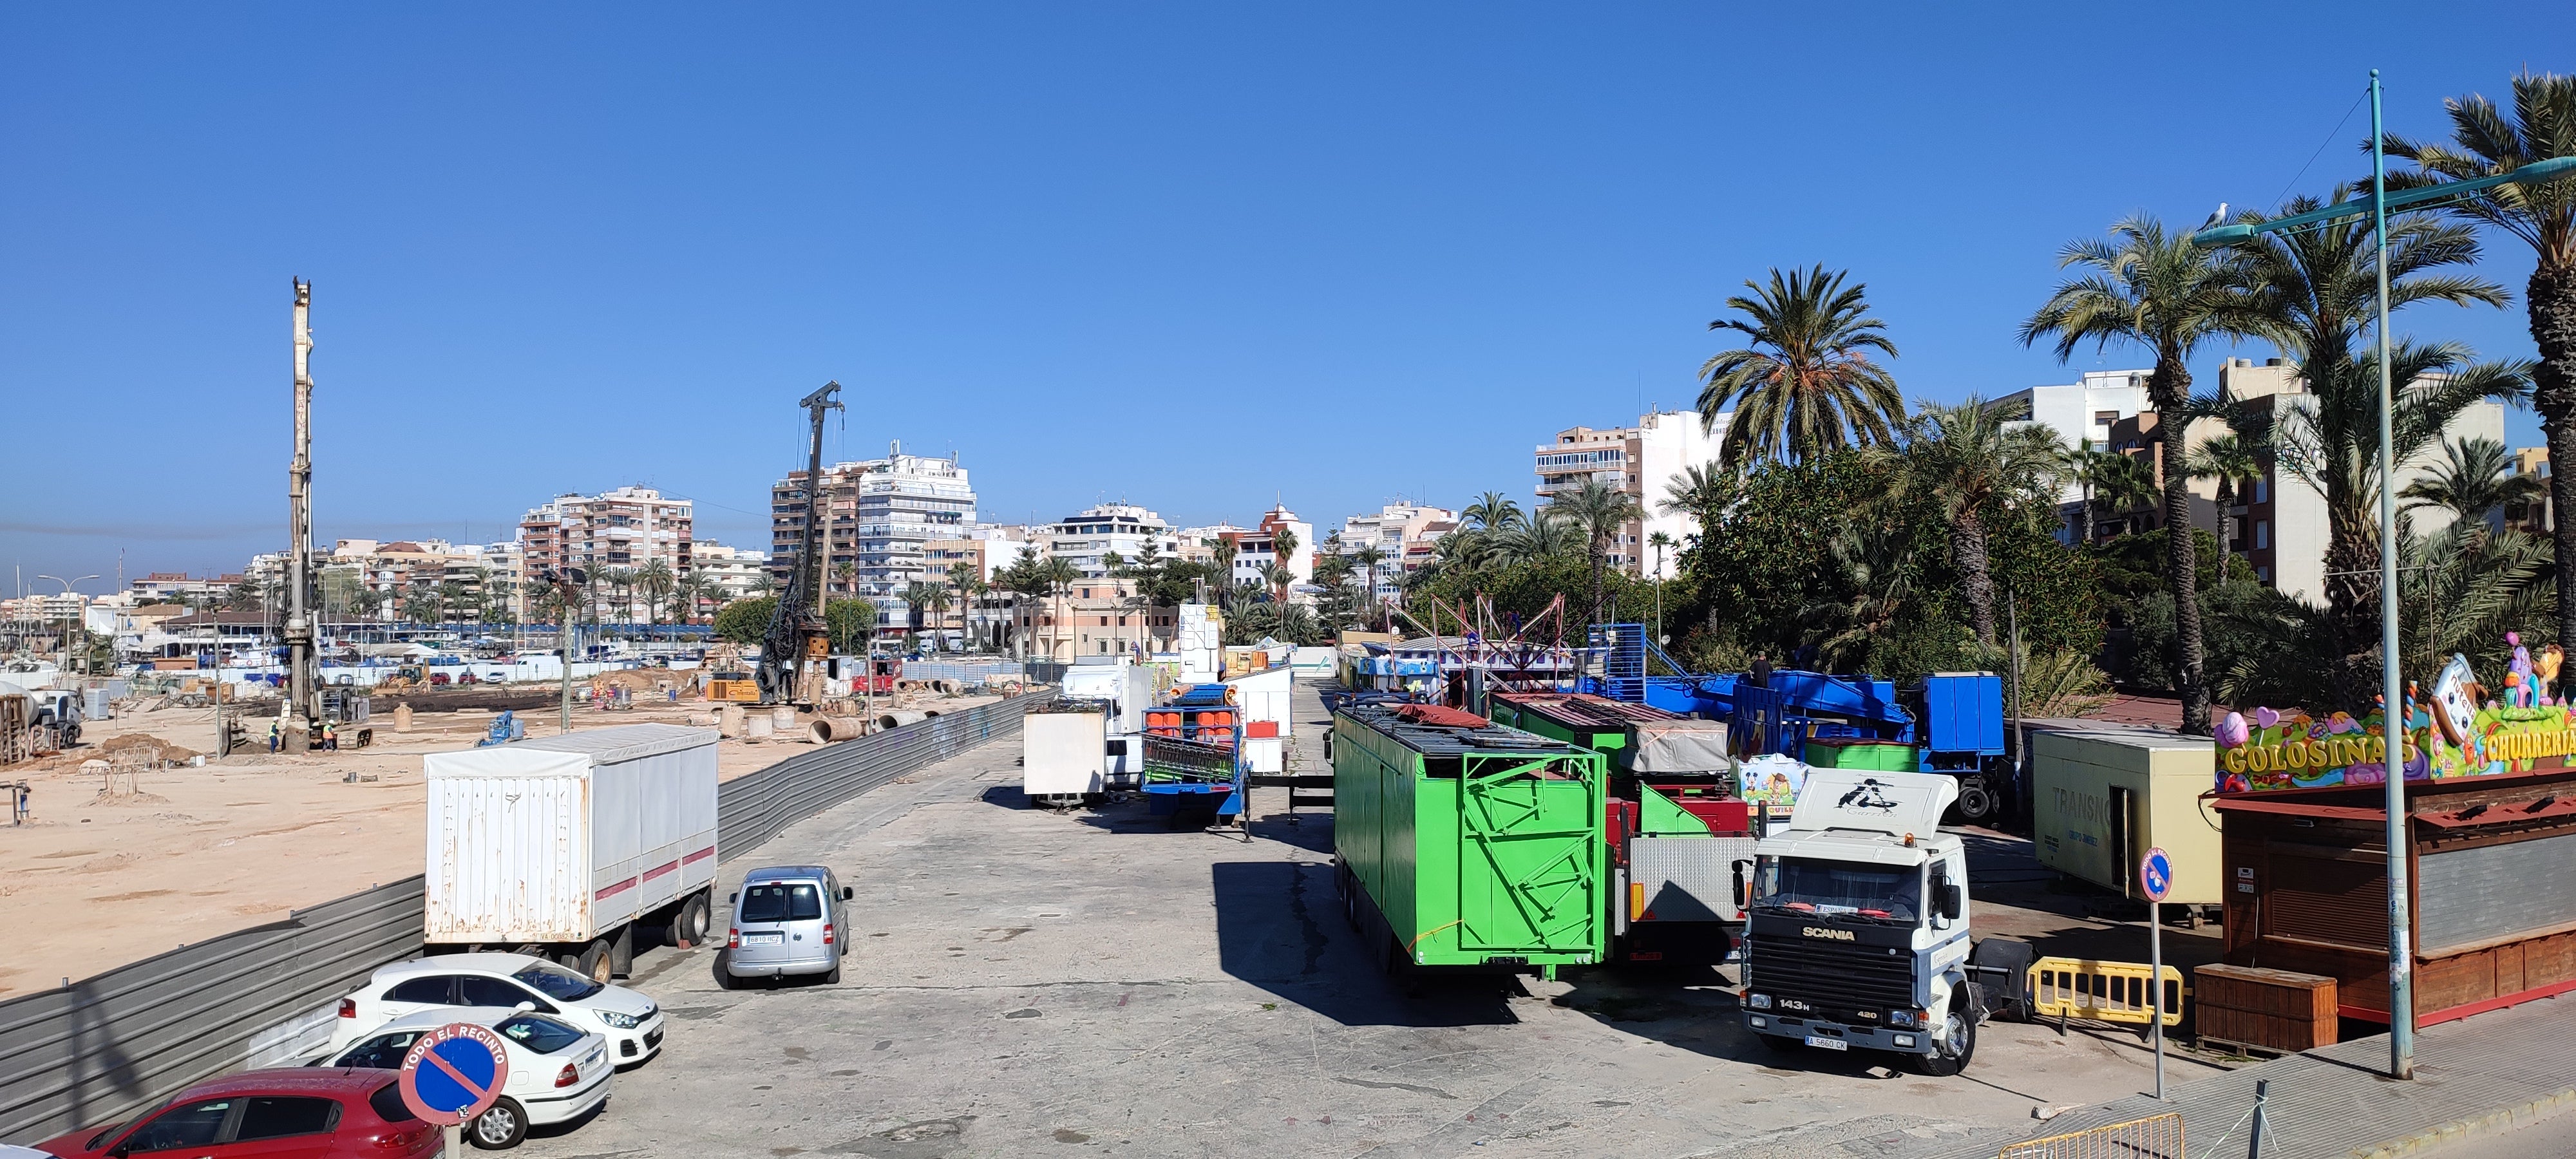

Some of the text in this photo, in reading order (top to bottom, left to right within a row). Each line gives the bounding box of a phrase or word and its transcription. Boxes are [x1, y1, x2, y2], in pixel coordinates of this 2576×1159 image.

[2451, 674, 2476, 721] nutella
[2225, 735, 2416, 773] GOLOSINAS
[2487, 729, 2576, 760] CHURRERIA
[2142, 854, 2151, 871] TODO
[2158, 849, 2172, 872] RECINTO
[1803, 927, 1855, 941] SCANIA
[403, 1026, 505, 1071] TODO EL RECINTO
[1816, 1039, 1833, 1048] 5660
